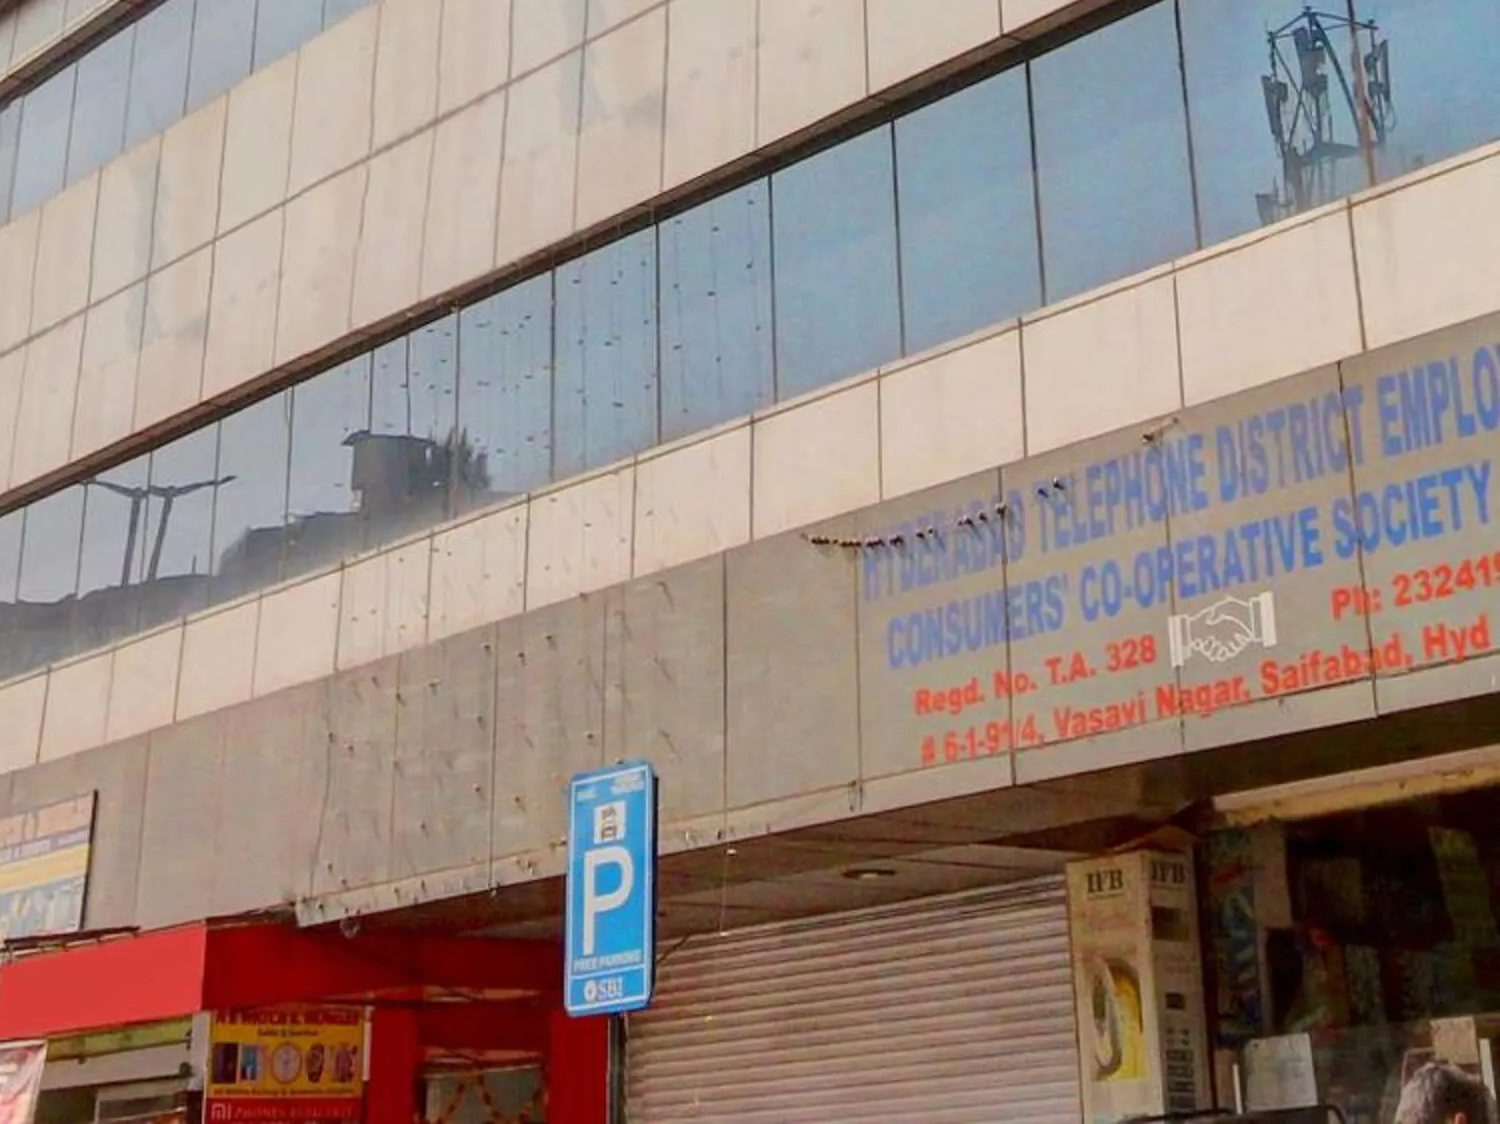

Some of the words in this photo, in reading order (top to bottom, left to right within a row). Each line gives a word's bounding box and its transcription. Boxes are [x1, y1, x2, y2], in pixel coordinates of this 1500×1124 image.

[1033, 434, 1209, 553] TELEPHONE
[1216, 384, 1365, 503] DISTRICT
[1376, 342, 1500, 457] EMPLO
[1080, 507, 1323, 622] CO-OPERATIVE
[1331, 460, 1492, 559] SOCIETY
[1330, 584, 1383, 620] Ph:
[914, 677, 985, 715] Regd.
[994, 671, 1038, 699] No.
[1044, 652, 1097, 686] T.A.
[1105, 634, 1158, 672] 328
[1053, 690, 1149, 739] Vasavi
[1422, 614, 1491, 664] Hyd
[582, 845, 634, 957] P
[1086, 868, 1124, 893] IFB
